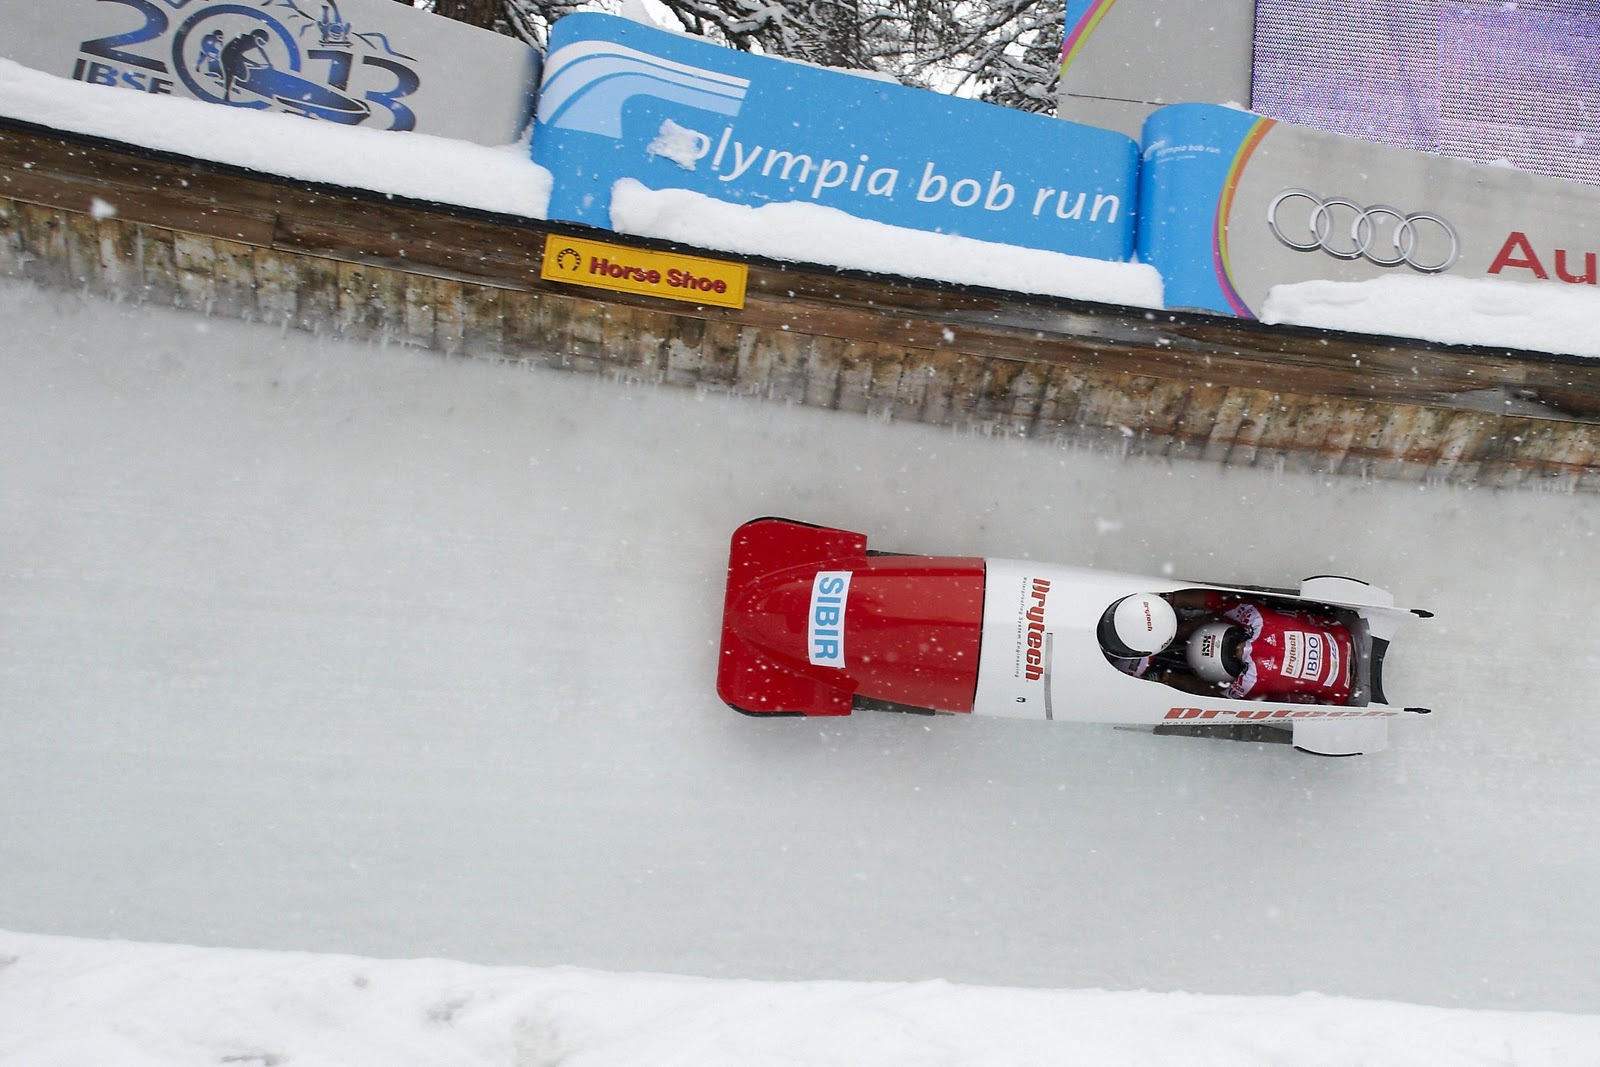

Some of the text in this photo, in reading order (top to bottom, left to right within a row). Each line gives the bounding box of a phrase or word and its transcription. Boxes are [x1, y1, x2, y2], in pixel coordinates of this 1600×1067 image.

[916, 161, 1015, 212] bob
[1032, 188, 1120, 224] run
[589, 256, 727, 294] Horse Shoe
[814, 576, 845, 660] SIBIR
[1025, 577, 1051, 681] Drytech
[1307, 636, 1318, 671] BDO
